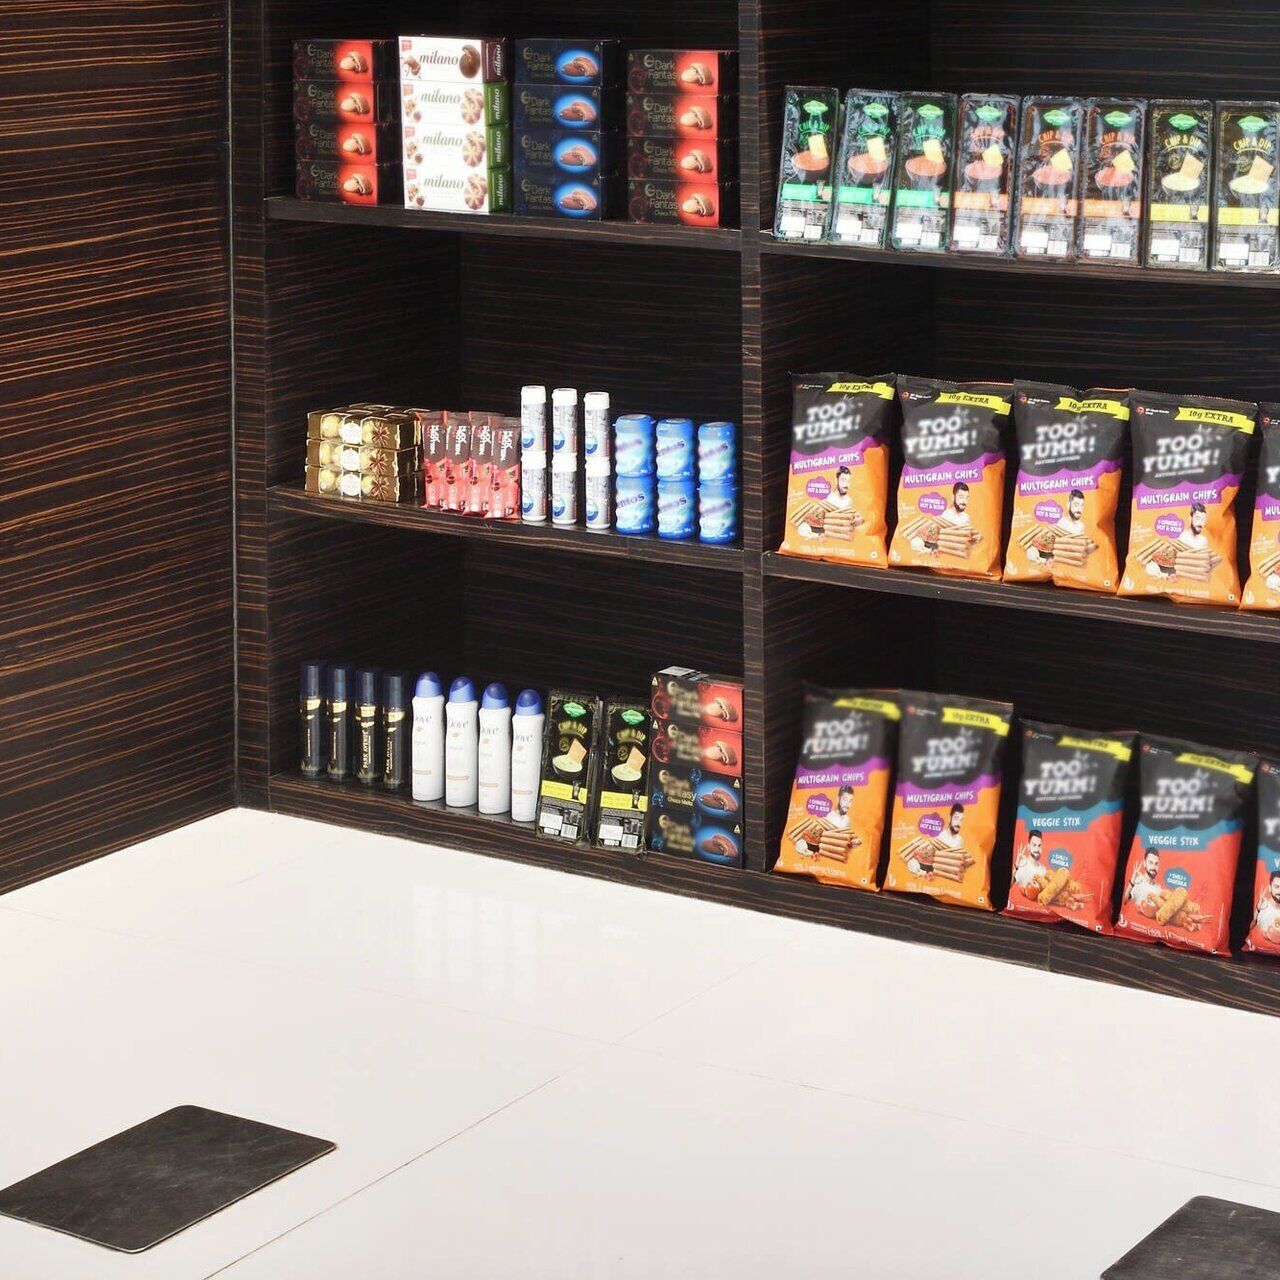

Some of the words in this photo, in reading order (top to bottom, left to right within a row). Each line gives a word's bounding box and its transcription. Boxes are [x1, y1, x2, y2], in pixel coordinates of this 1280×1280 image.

[420, 49, 459, 65] milano
[494, 44, 502, 77] milano
[654, 60, 674, 69] Dark
[421, 88, 461, 104] milano
[653, 104, 674, 113] Dark
[422, 131, 463, 147] milano
[654, 147, 674, 156] Dark
[424, 173, 464, 189] milano
[656, 190, 677, 200] Dark
[807, 401, 847, 420] TOO
[1081, 402, 1108, 411] EXTRA
[918, 417, 960, 434] TOO
[1203, 412, 1235, 424] EXTRA
[794, 414, 861, 440] YUMM!
[1036, 423, 1078, 442] TOO
[905, 429, 977, 454] YUMM!
[1021, 437, 1096, 461] YUMM!
[1156, 434, 1204, 455] TOO
[794, 456, 836, 470] MULTIGRAIN
[838, 452, 861, 463] CHIPS
[1142, 450, 1221, 473] YUMM!
[904, 472, 953, 484] MULTIGRAIN
[955, 469, 979, 480] CHIPS
[1020, 480, 1069, 492] MULTIGRAIN
[1071, 476, 1094, 487] CHIPS
[1140, 492, 1189, 505] MULTIGRAIN
[1192, 488, 1218, 500] CHIPS
[815, 721, 855, 737] TOO
[927, 738, 967, 754] TOO
[1040, 760, 1081, 778] TOO
[798, 773, 840, 784] MULTIGRAIN
[842, 771, 865, 782] CHIPS
[1025, 776, 1097, 795] YUMM!
[1156, 778, 1202, 795] TOO
[906, 792, 952, 803] MULTIGRAIN
[954, 790, 975, 801] CHIPS
[1142, 795, 1215, 813] YUMM!
[1032, 817, 1060, 827] VEGGIE
[1062, 816, 1081, 826] STIX
[1148, 835, 1178, 846] VEGGIE
[1180, 836, 1199, 846] STIX
